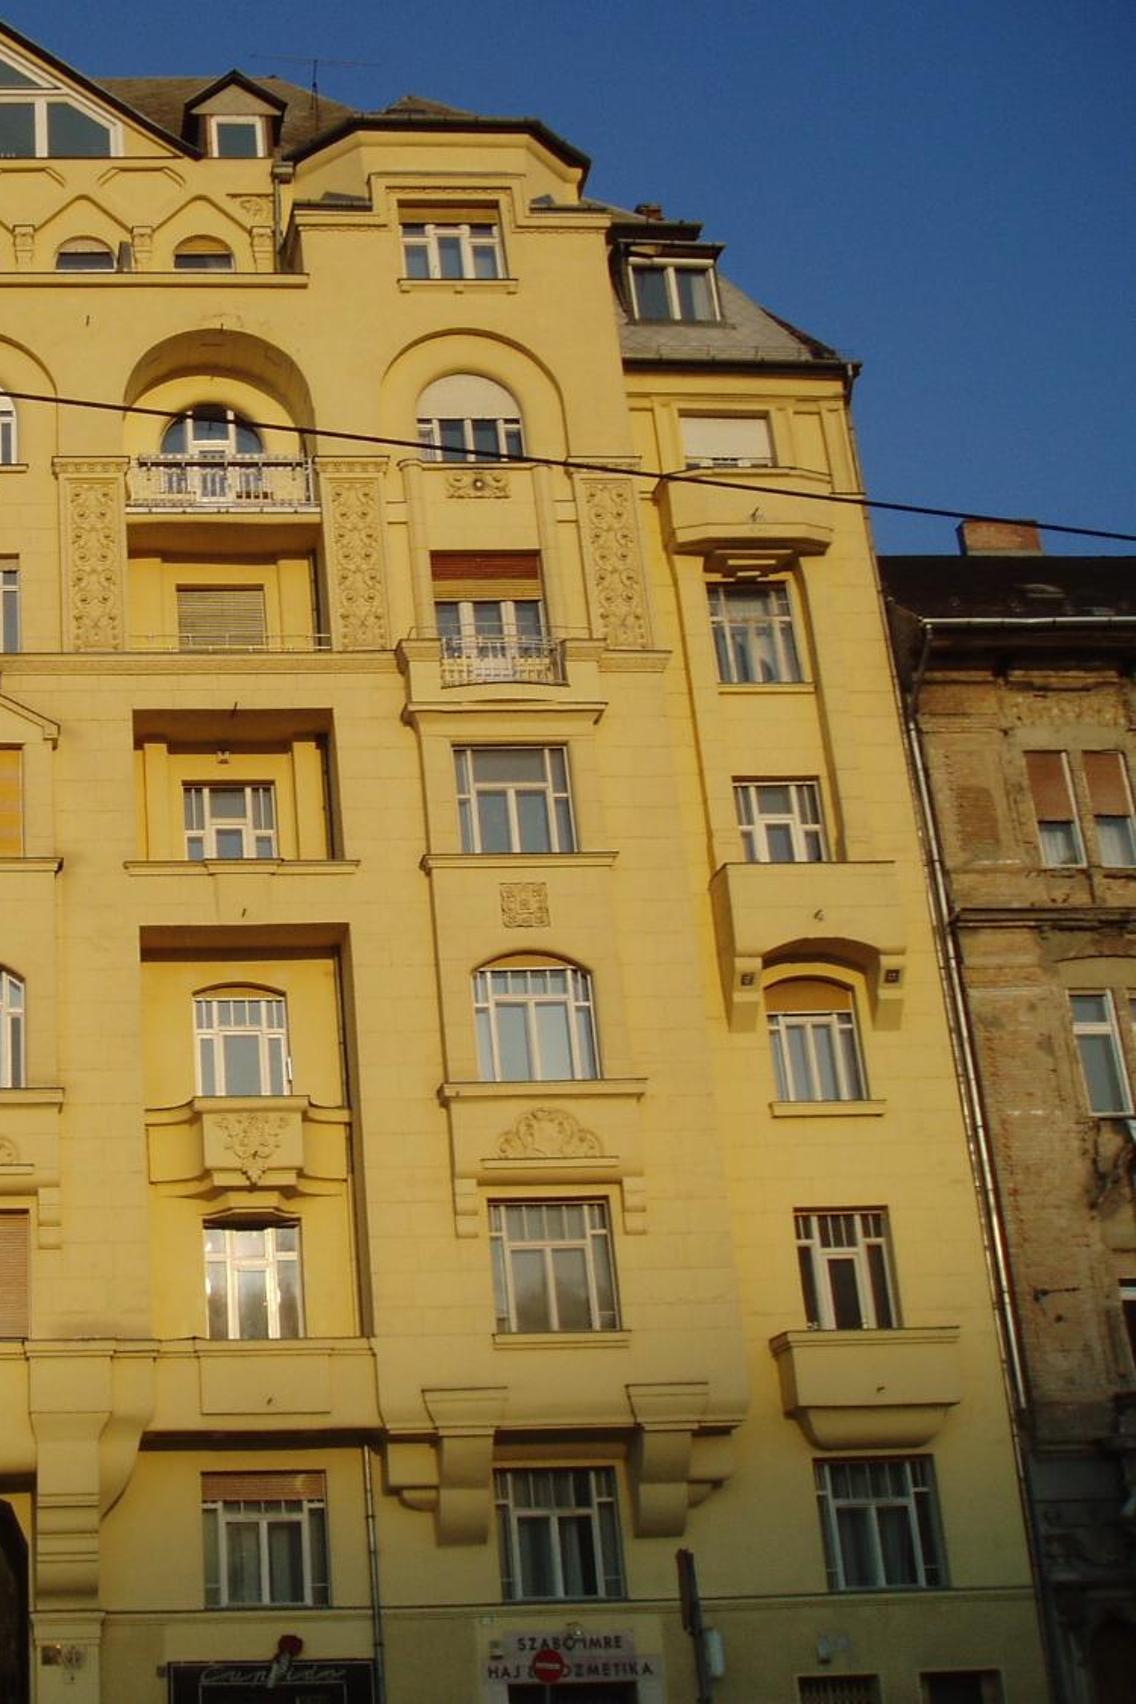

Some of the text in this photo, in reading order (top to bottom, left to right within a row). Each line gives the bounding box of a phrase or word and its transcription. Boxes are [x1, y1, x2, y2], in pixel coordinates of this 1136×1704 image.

[517, 1634, 623, 1651] SZABÓ IMRE
[487, 1665, 520, 1679] HAJ
[562, 1662, 654, 1678] OZMETIKA
